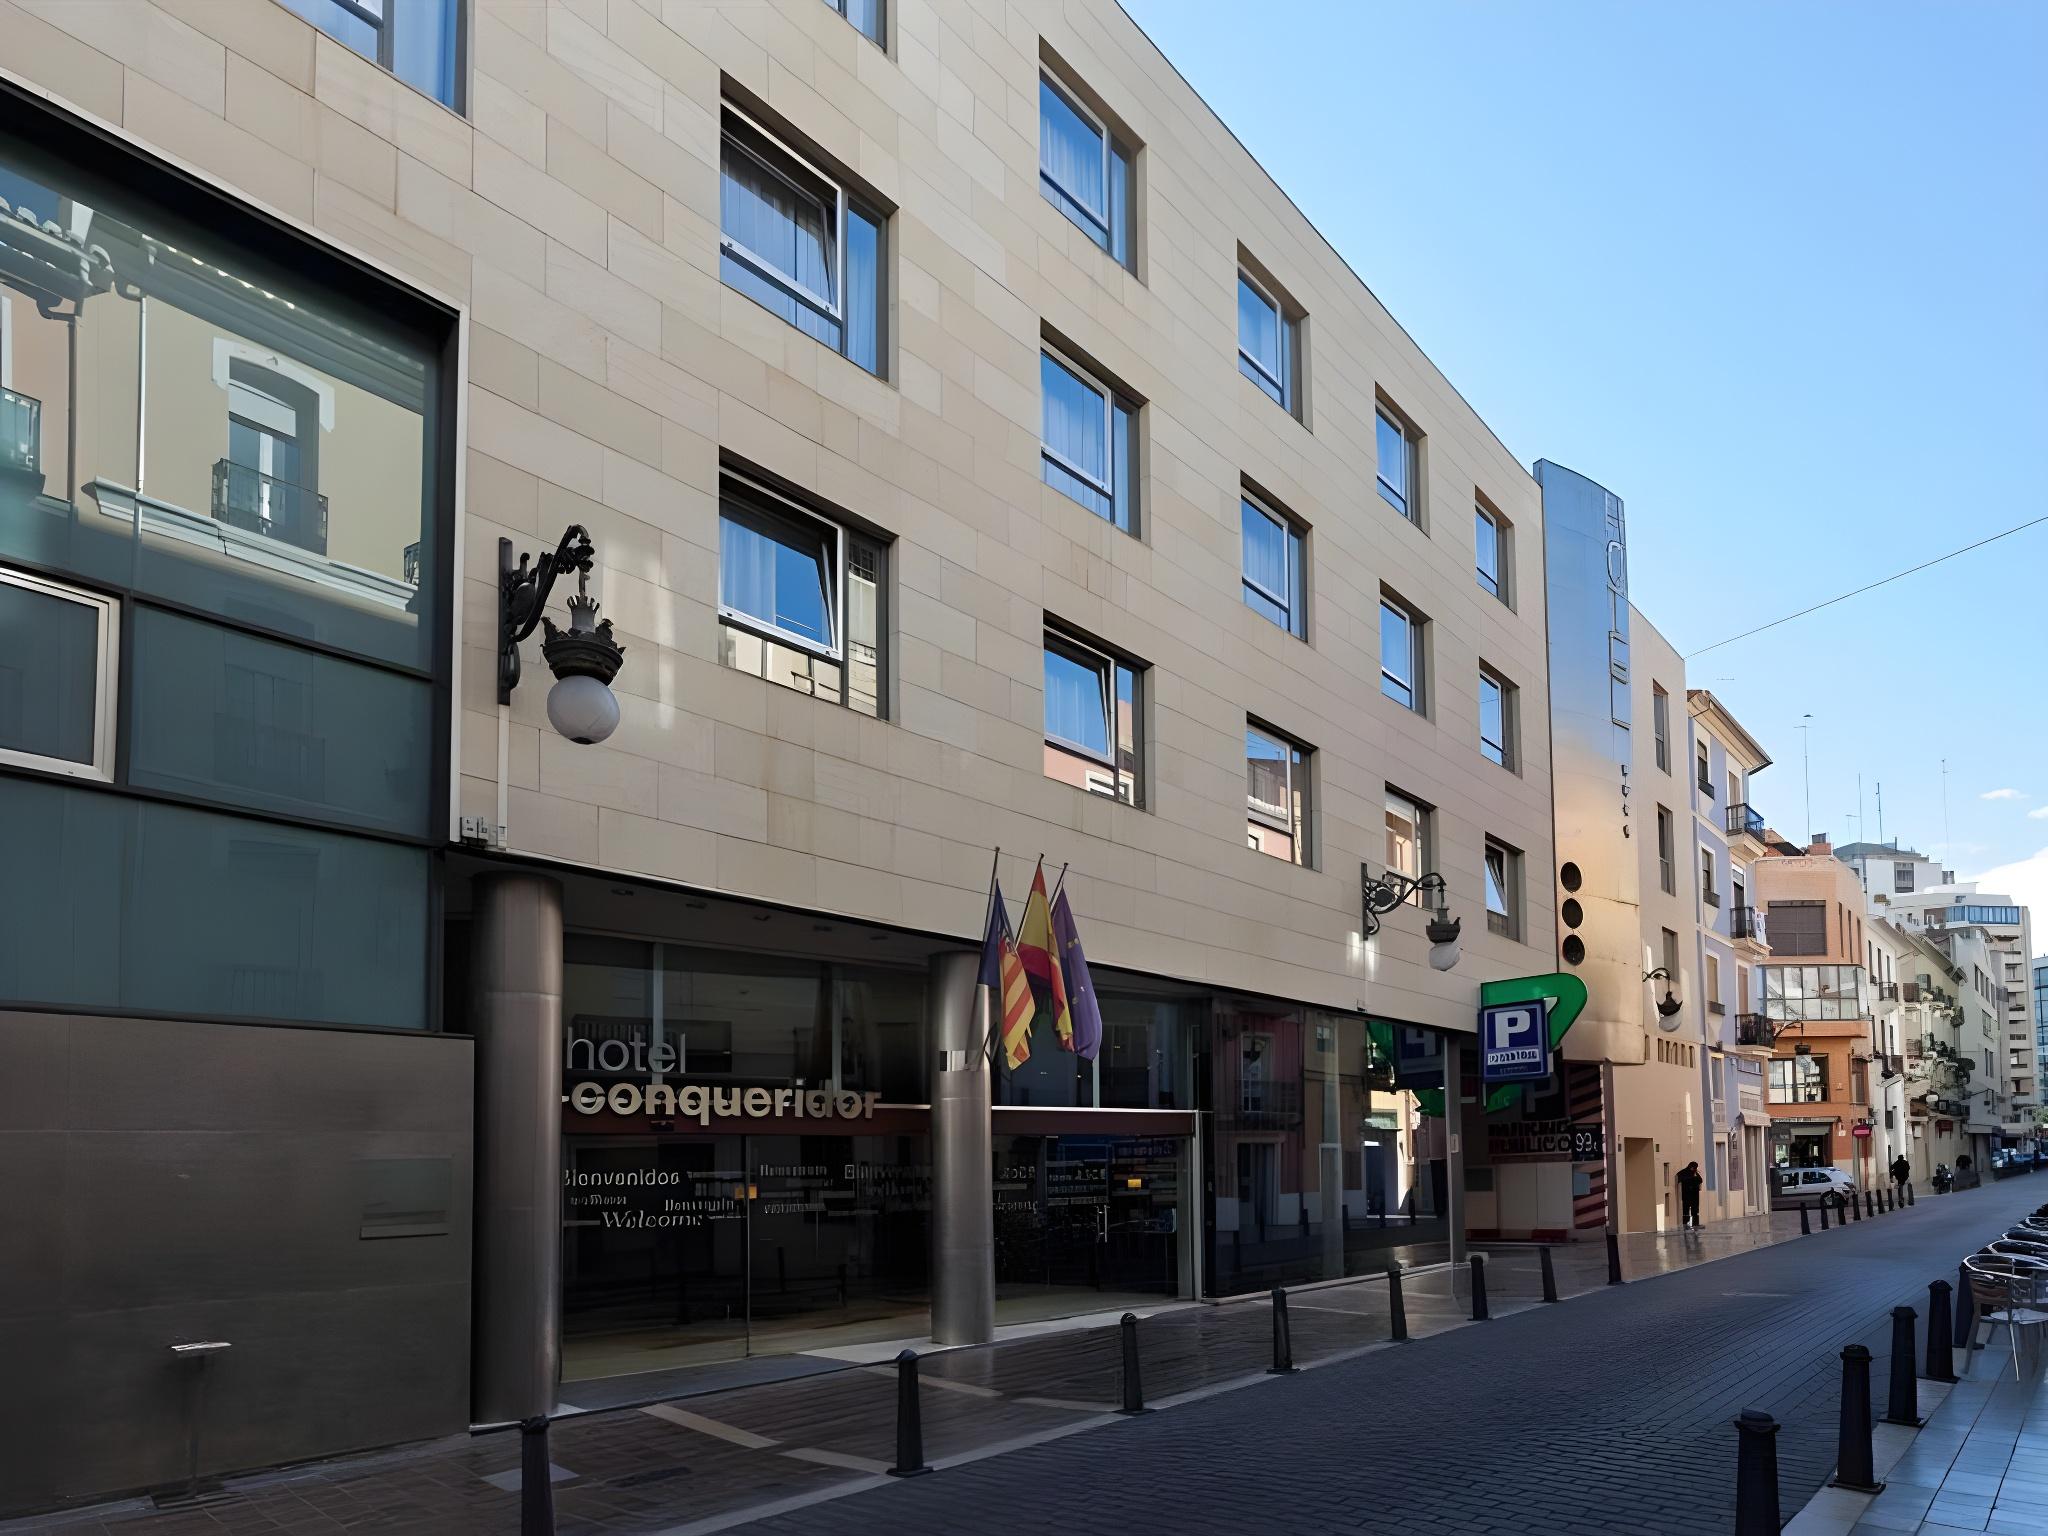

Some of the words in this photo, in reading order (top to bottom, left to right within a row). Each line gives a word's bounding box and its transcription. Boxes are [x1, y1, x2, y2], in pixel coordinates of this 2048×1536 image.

[567, 1026, 686, 1073] hotel
[1495, 1010, 1531, 1048] P
[571, 1080, 882, 1126] conqueridor
